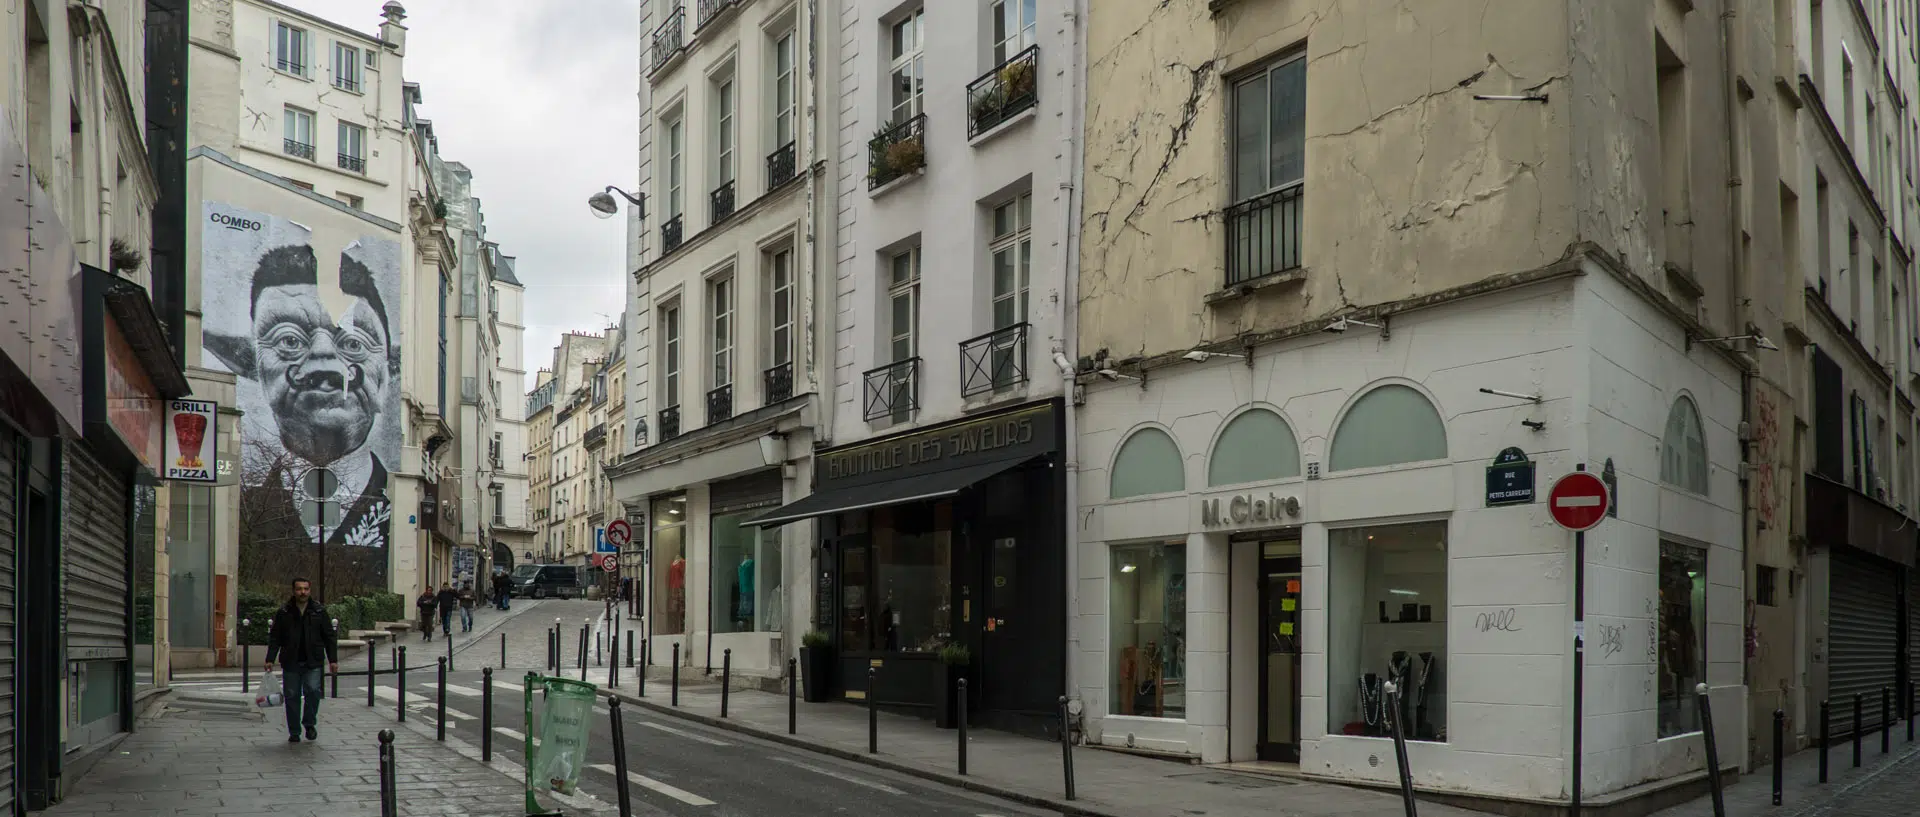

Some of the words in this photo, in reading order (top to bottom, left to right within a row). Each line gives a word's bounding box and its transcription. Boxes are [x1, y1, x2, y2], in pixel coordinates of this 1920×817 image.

[210, 212, 262, 231] COMBO
[171, 401, 211, 413] GRILL
[829, 446, 902, 480] BOUTIQUE
[908, 436, 942, 465] DES
[950, 417, 1033, 457] SAVEURS
[169, 468, 209, 478] PIZZA
[1504, 471, 1515, 479] RUE
[1489, 491, 1505, 499] PETITS
[1505, 489, 1531, 498] CARREAUX
